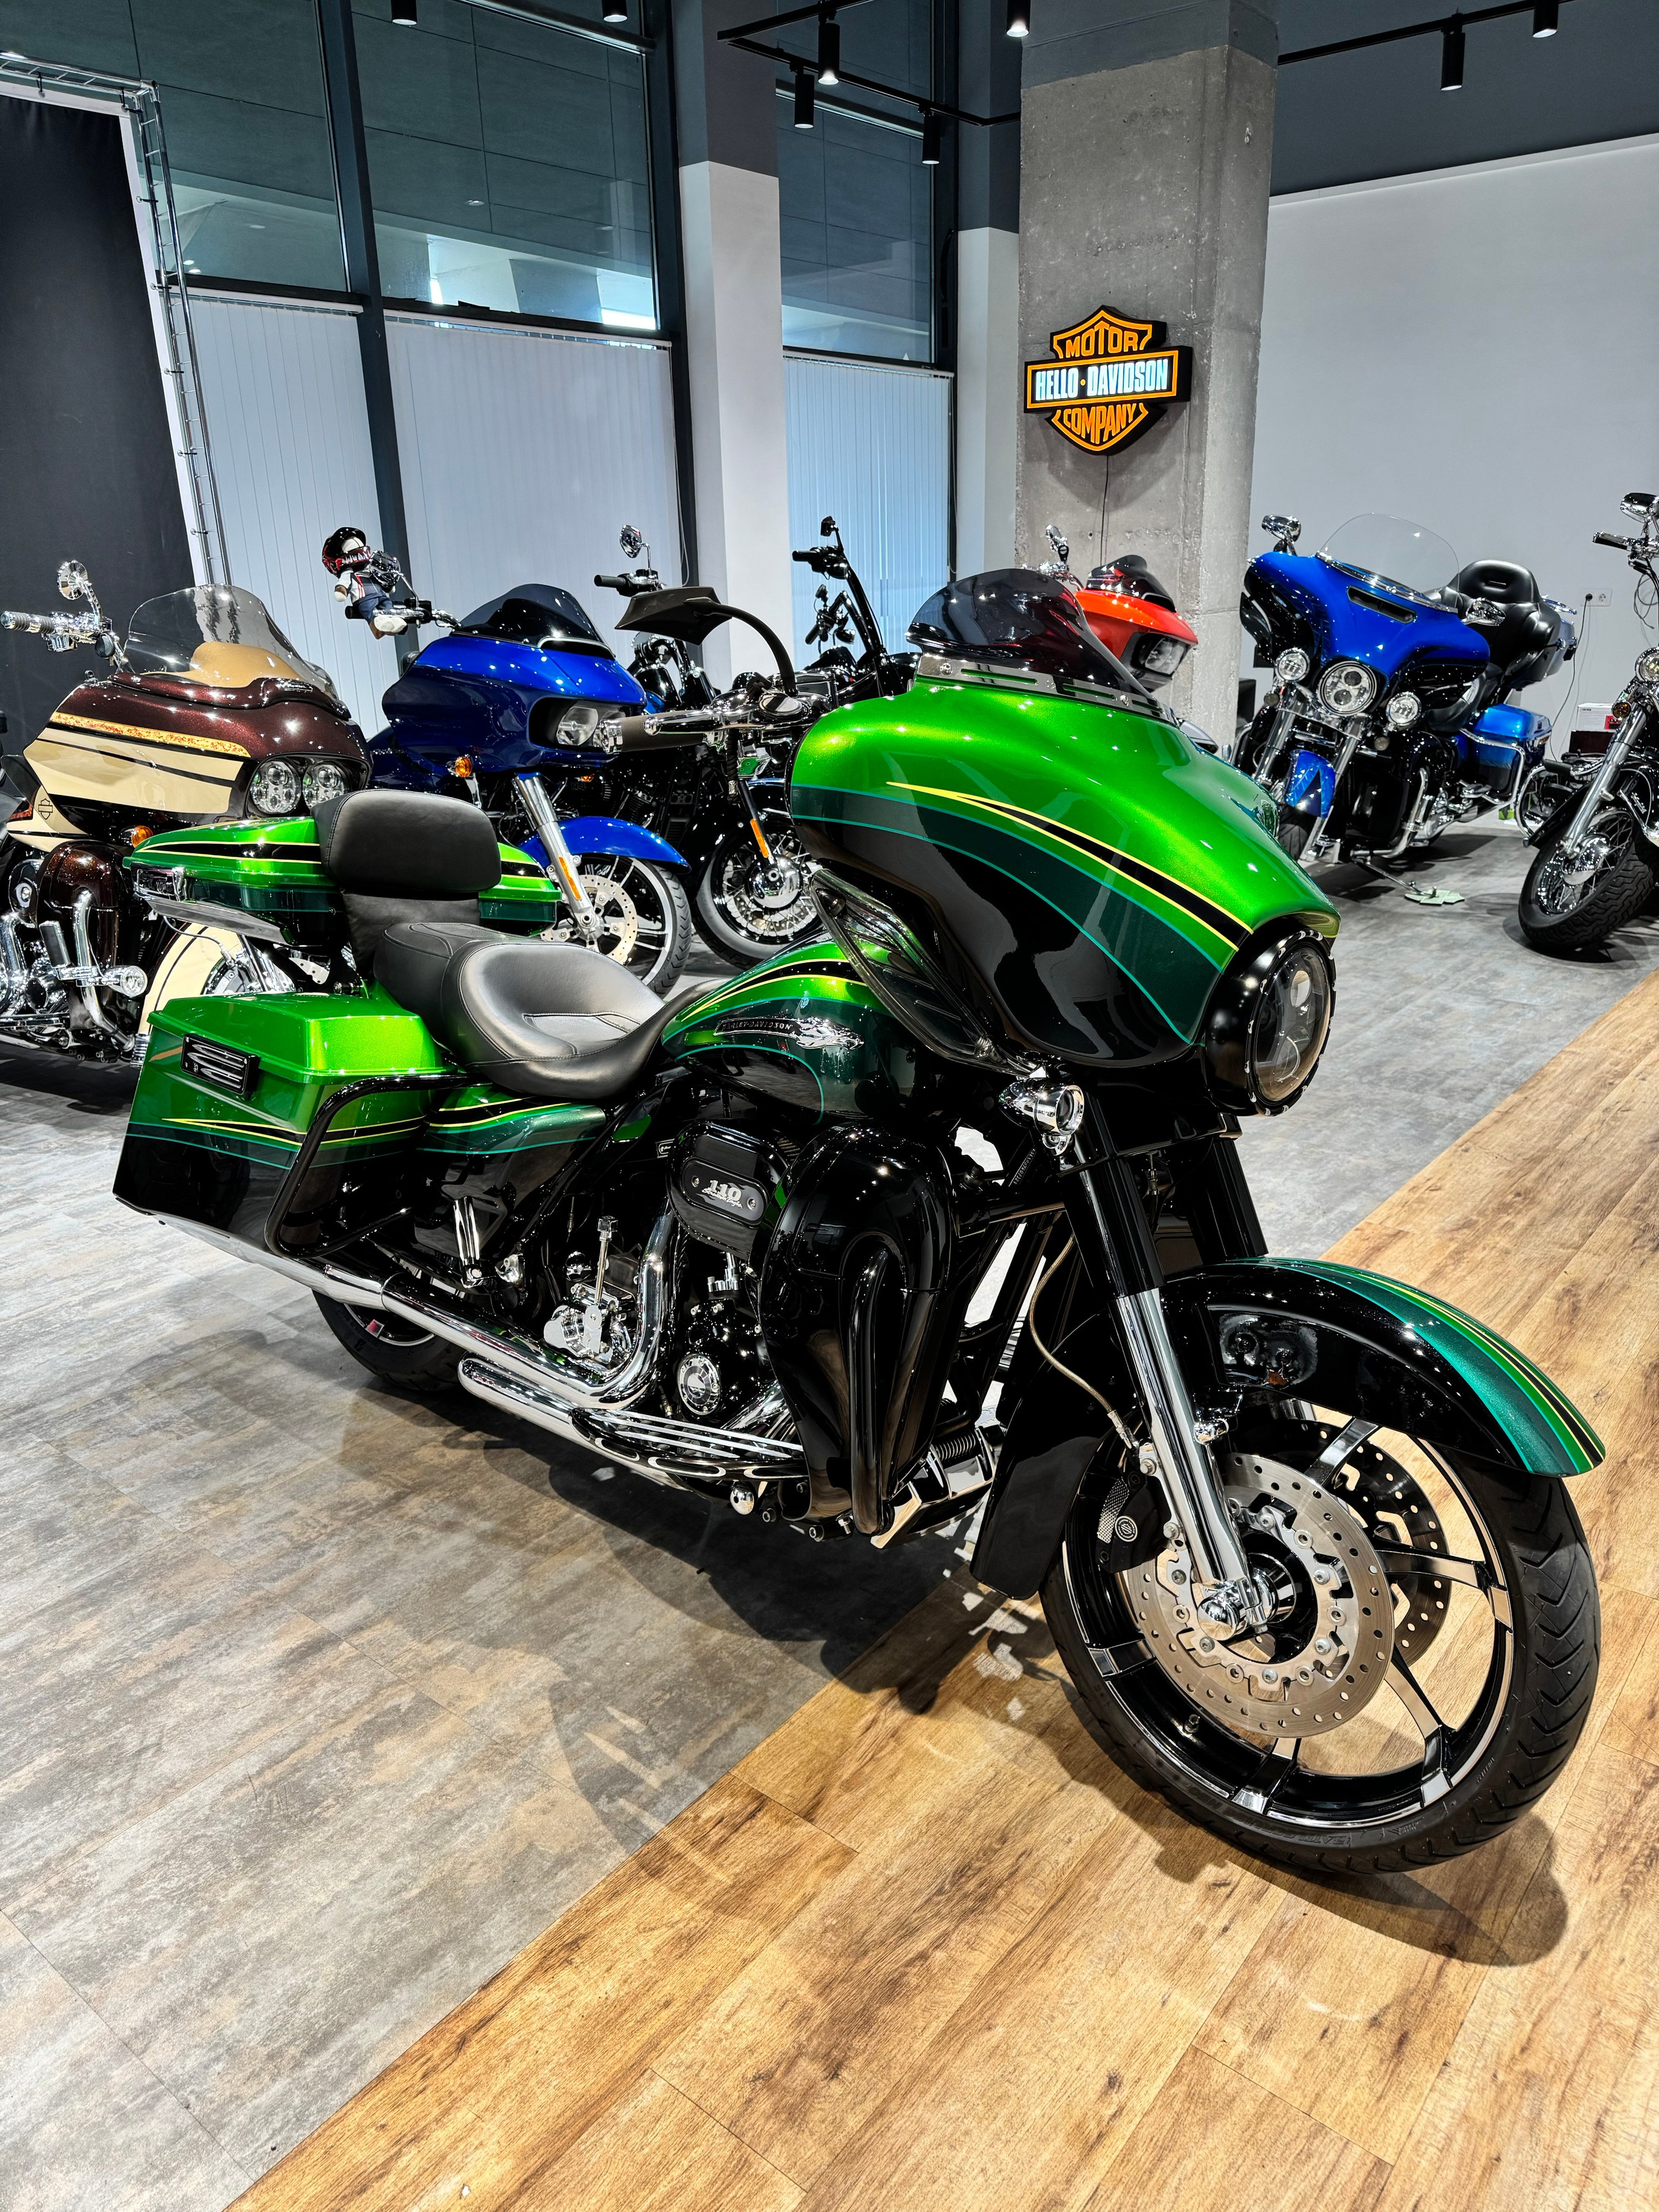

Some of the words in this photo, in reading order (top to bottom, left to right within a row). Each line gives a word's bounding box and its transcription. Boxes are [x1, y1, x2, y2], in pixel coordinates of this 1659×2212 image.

[1066, 320, 1137, 358] MOTOR
[1036, 367, 1079, 401] HELLO
[1087, 358, 1168, 397] DAVIDSON
[1063, 402, 1137, 444] COMPANY
[710, 1180, 741, 1201] 110
